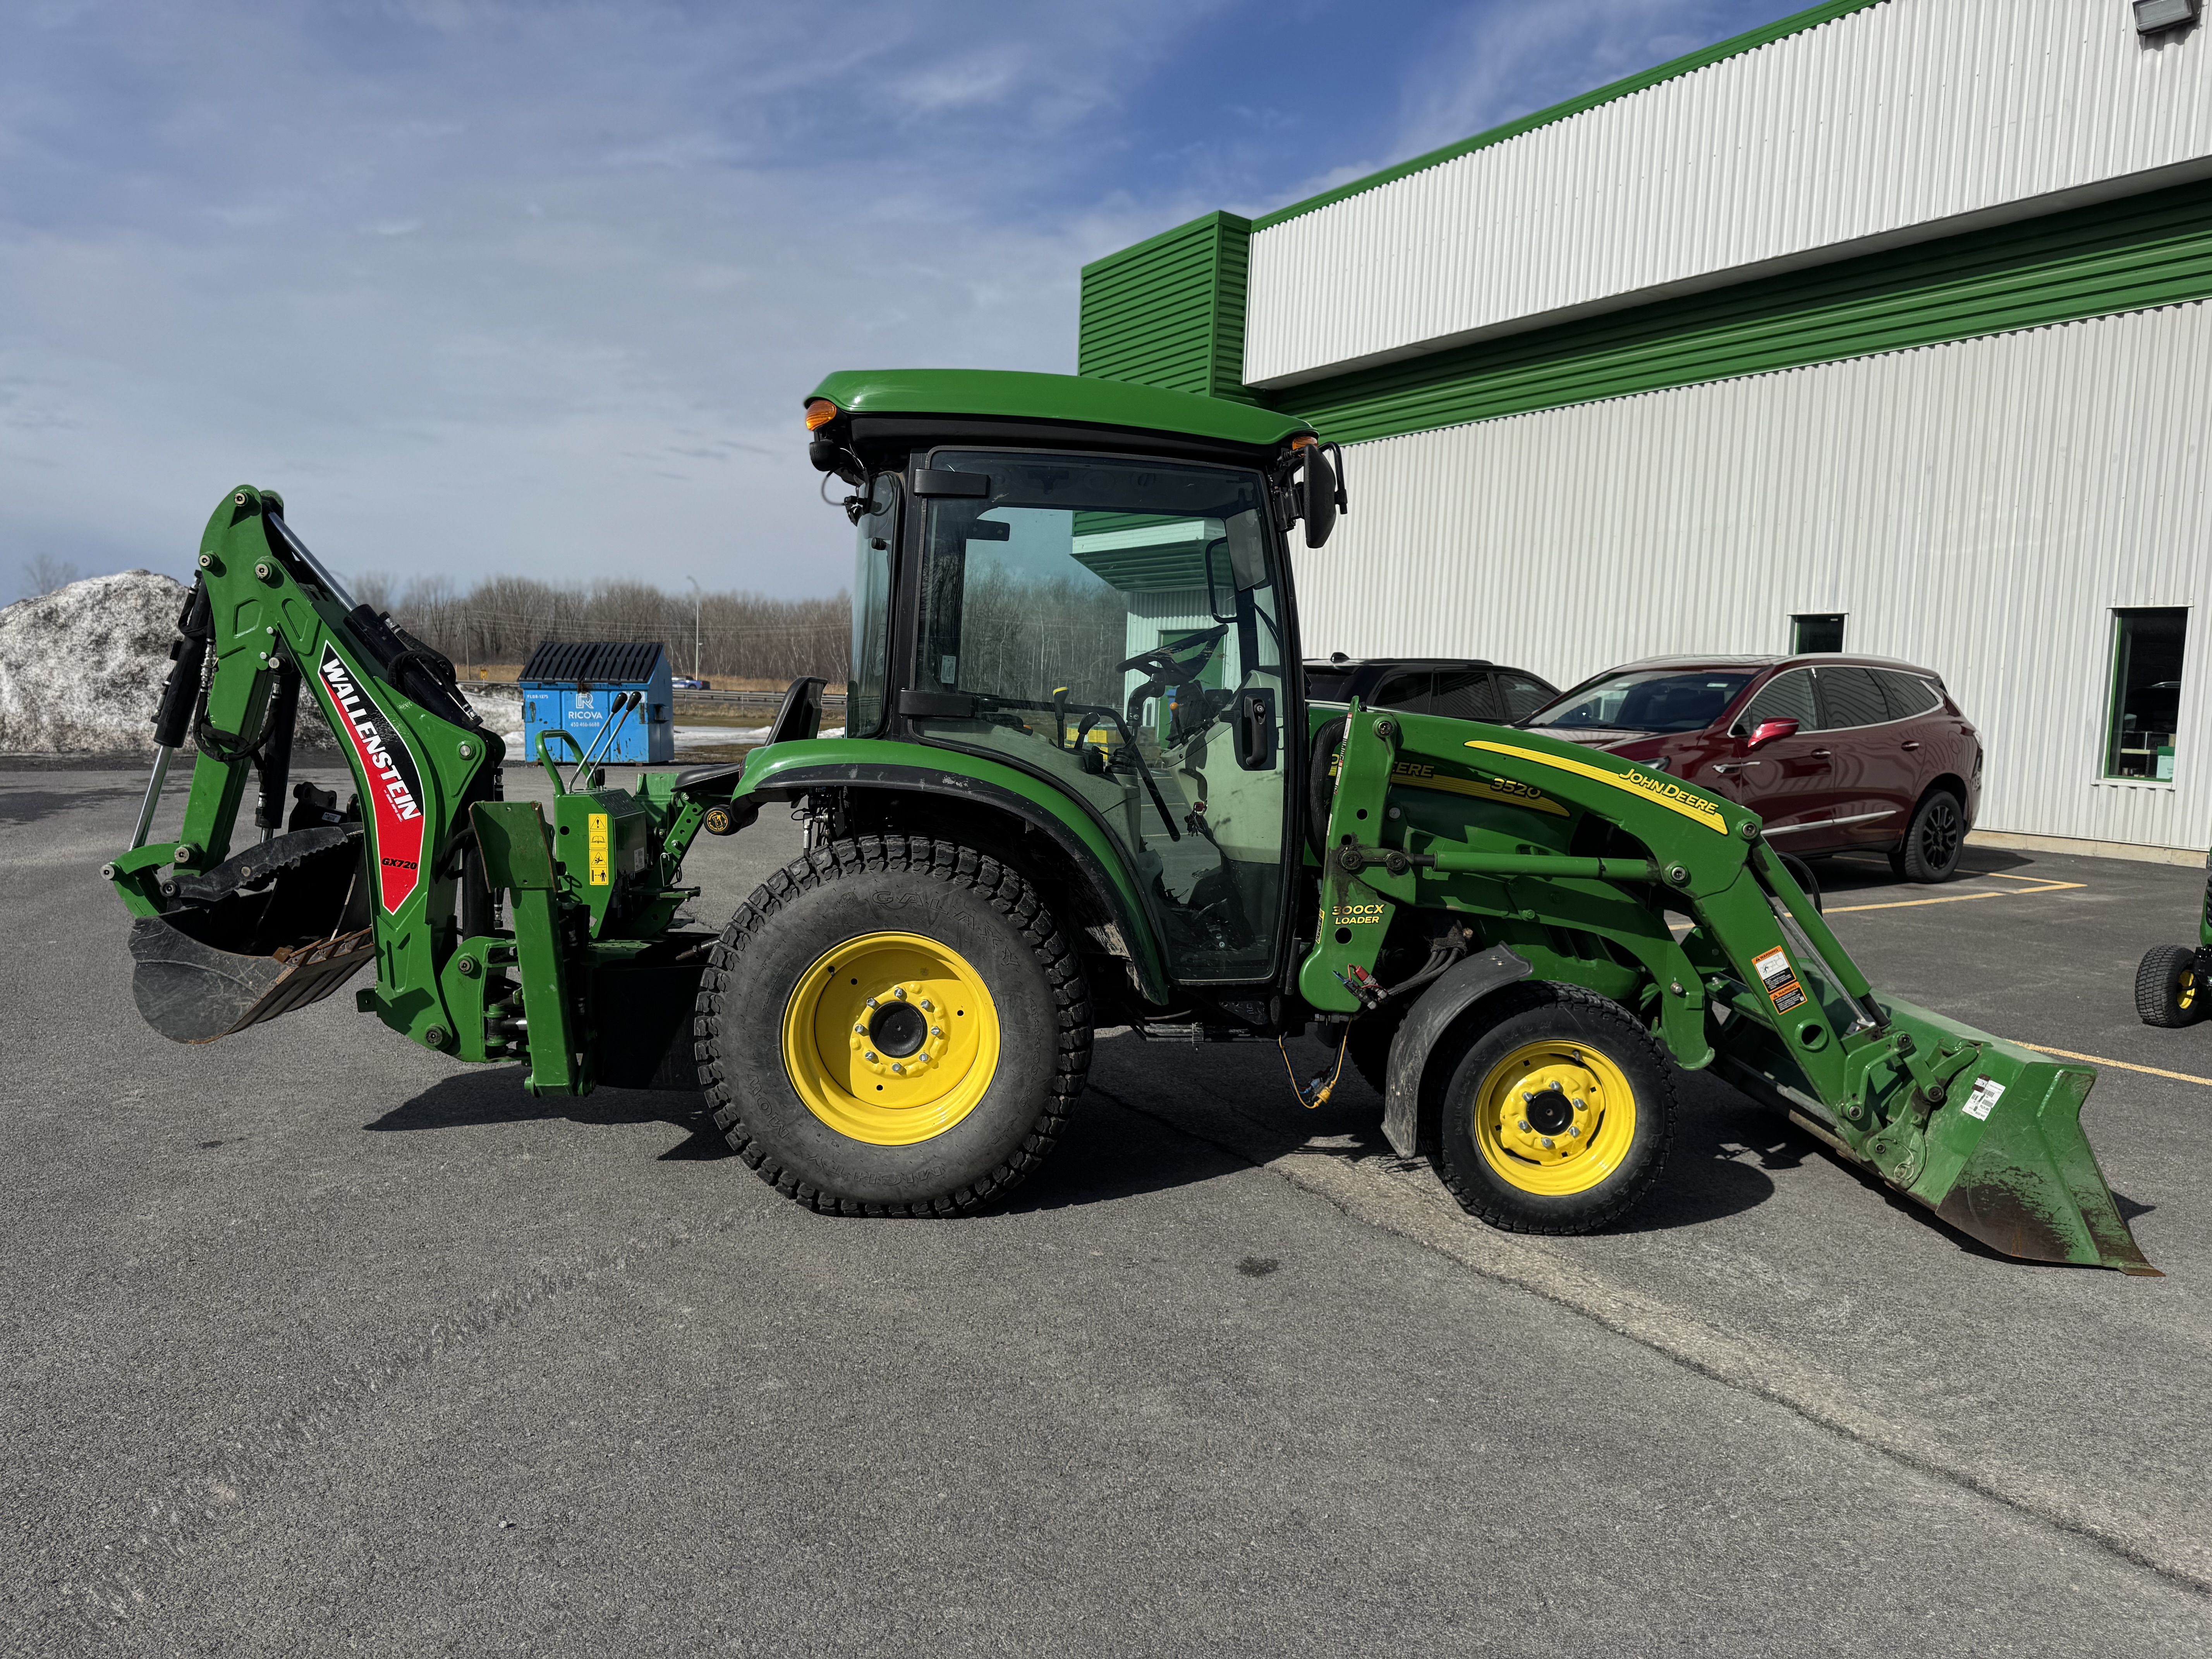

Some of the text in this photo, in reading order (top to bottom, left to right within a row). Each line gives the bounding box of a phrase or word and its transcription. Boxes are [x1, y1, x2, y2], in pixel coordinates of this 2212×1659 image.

[323, 658, 422, 820] WALLENSTEIN
[1391, 761, 1541, 798] ERE 3520
[1619, 768, 1719, 814] JOHN DEERE
[381, 857, 417, 870] GX720
[1332, 904, 1385, 915] 300CX
[1335, 916, 1380, 925] LOADER
[872, 890, 1021, 967] GALAXY
[1760, 948, 1778, 960] WARNING
[1778, 984, 1797, 996] WARNING
[747, 1073, 944, 1186] MIGHTY MOW
